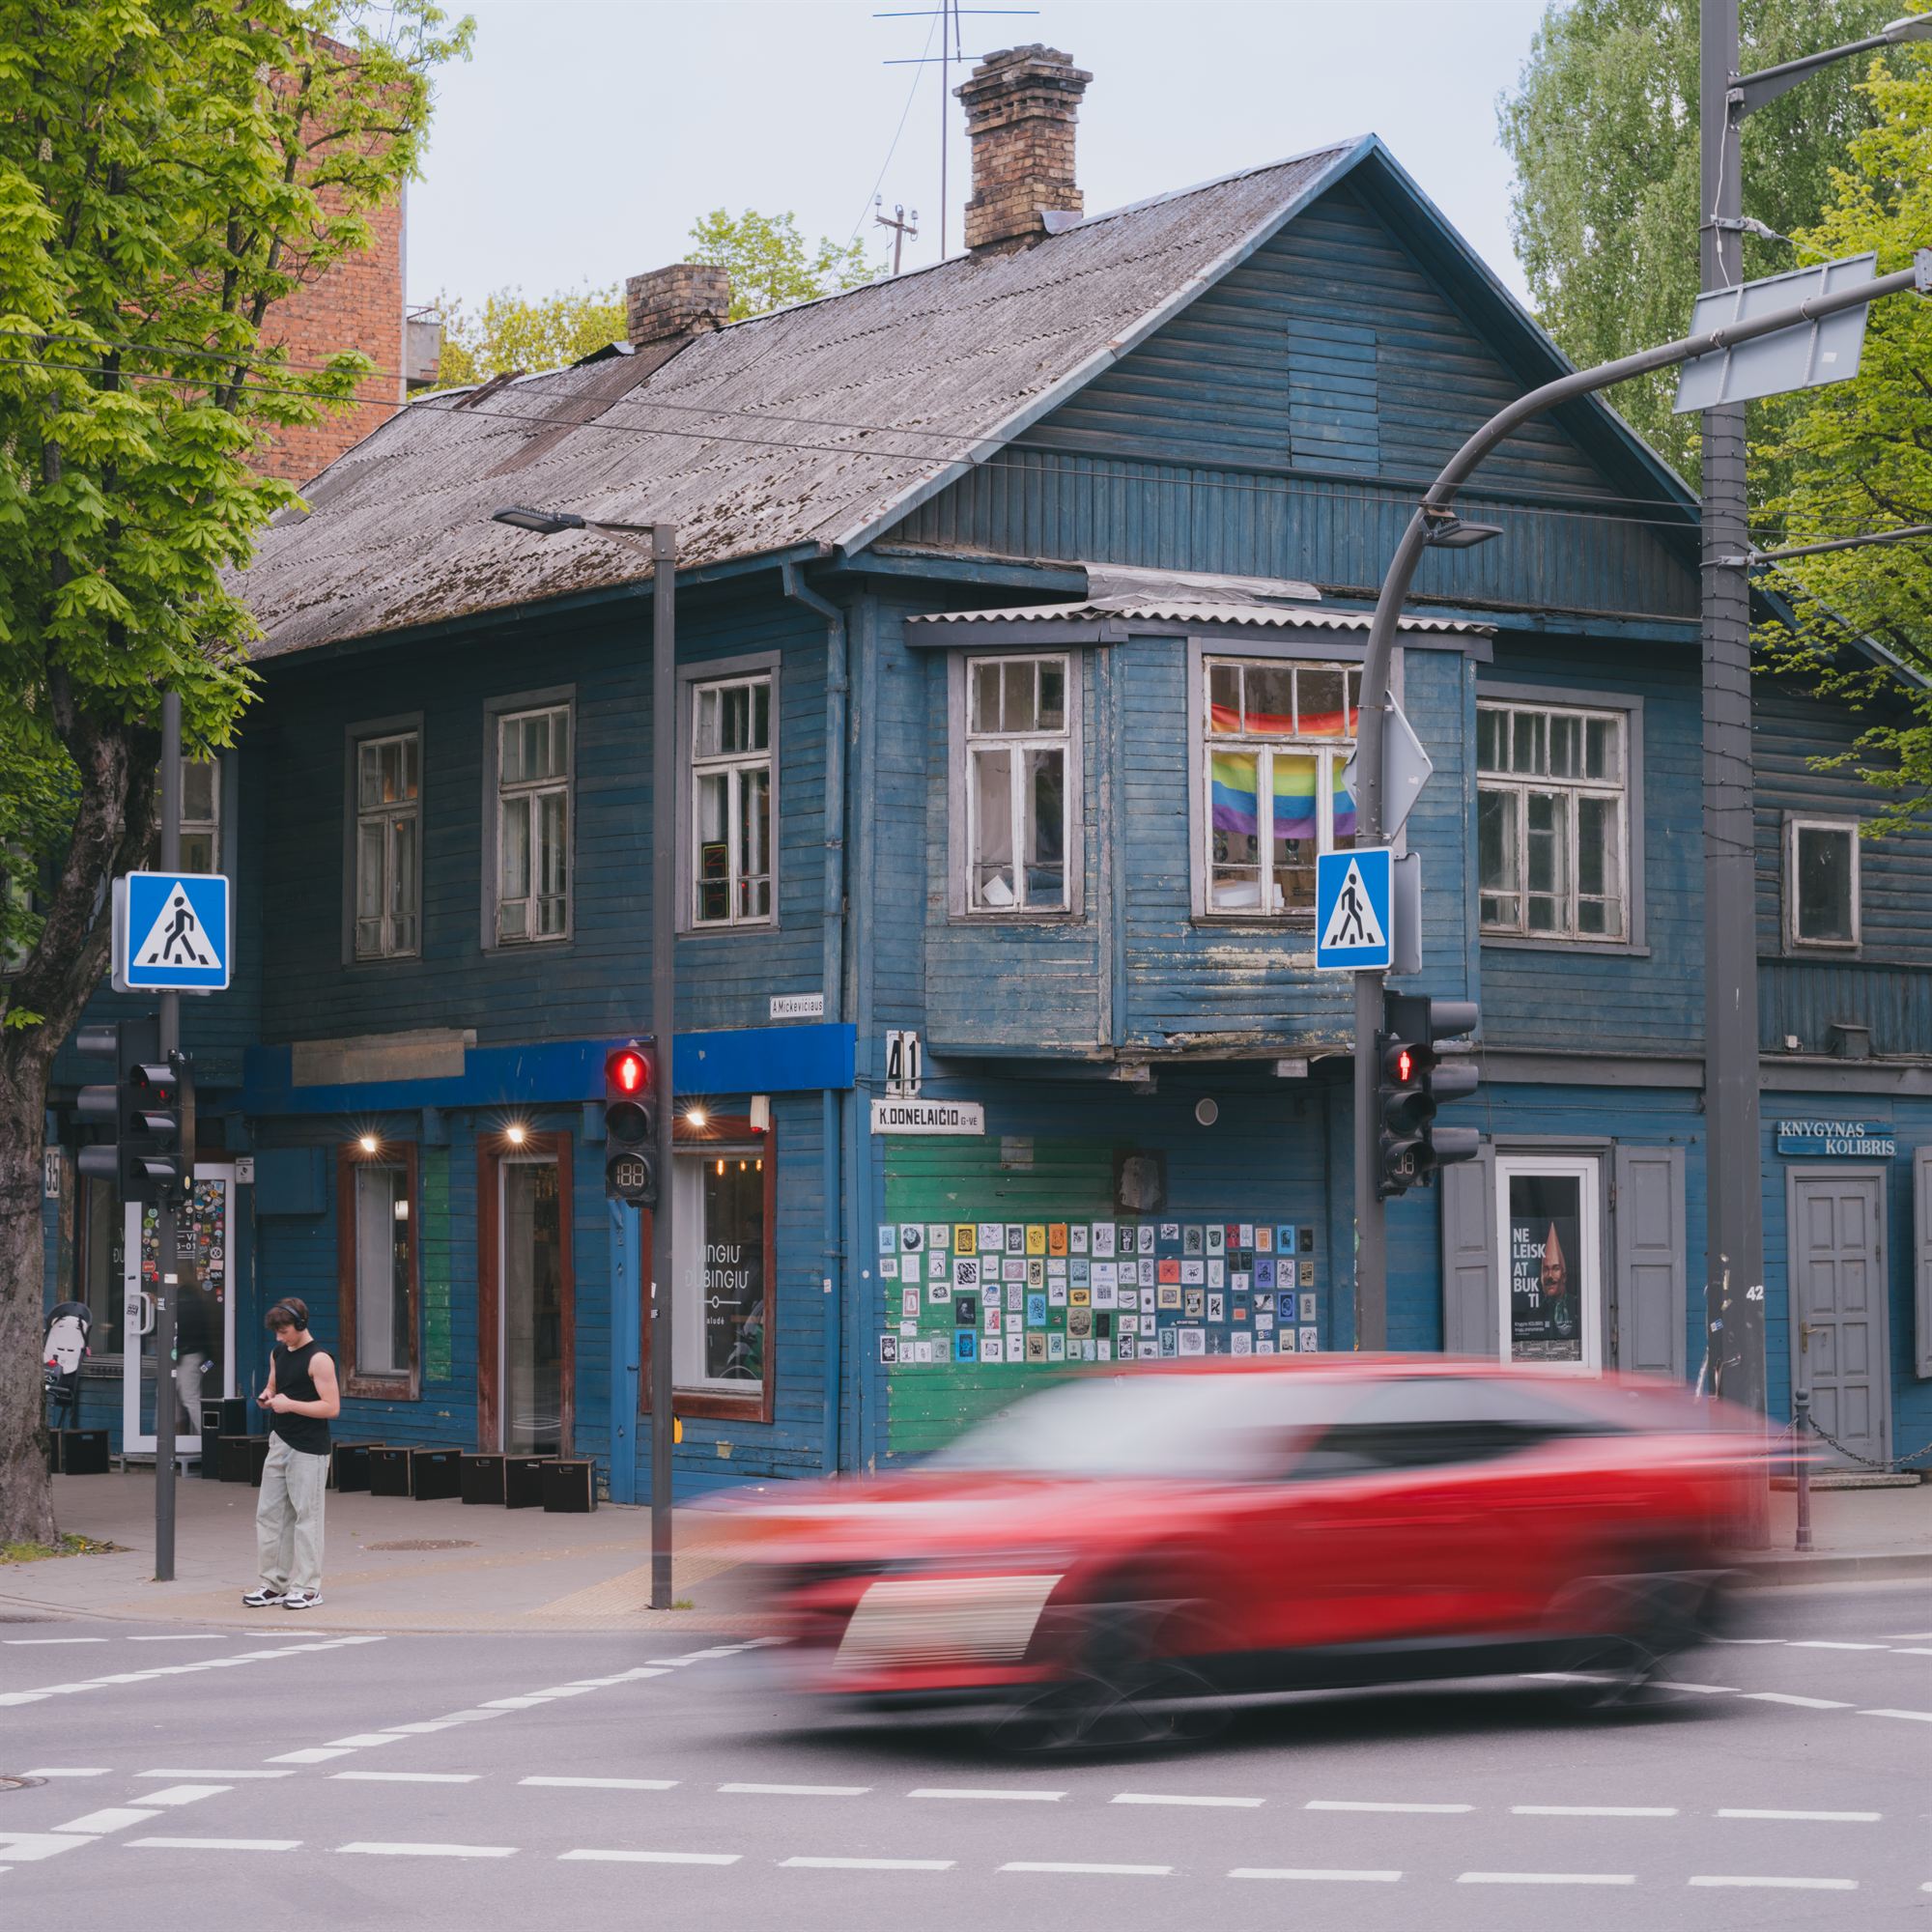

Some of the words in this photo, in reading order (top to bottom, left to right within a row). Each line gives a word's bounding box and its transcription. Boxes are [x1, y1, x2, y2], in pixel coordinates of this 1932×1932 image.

[888, 1039, 917, 1091] 41
[1780, 1122, 1864, 1138] KNYGYNAS
[1825, 1139, 1895, 1155] KOLIBRIS
[46, 1153, 59, 1191] 35
[1513, 1228, 1530, 1243] NE
[1513, 1243, 1547, 1259] LEISK
[1513, 1262, 1529, 1277] AT
[1513, 1277, 1540, 1293] BUK
[1747, 1285, 1764, 1301] 42
[1528, 1293, 1540, 1308] TI
